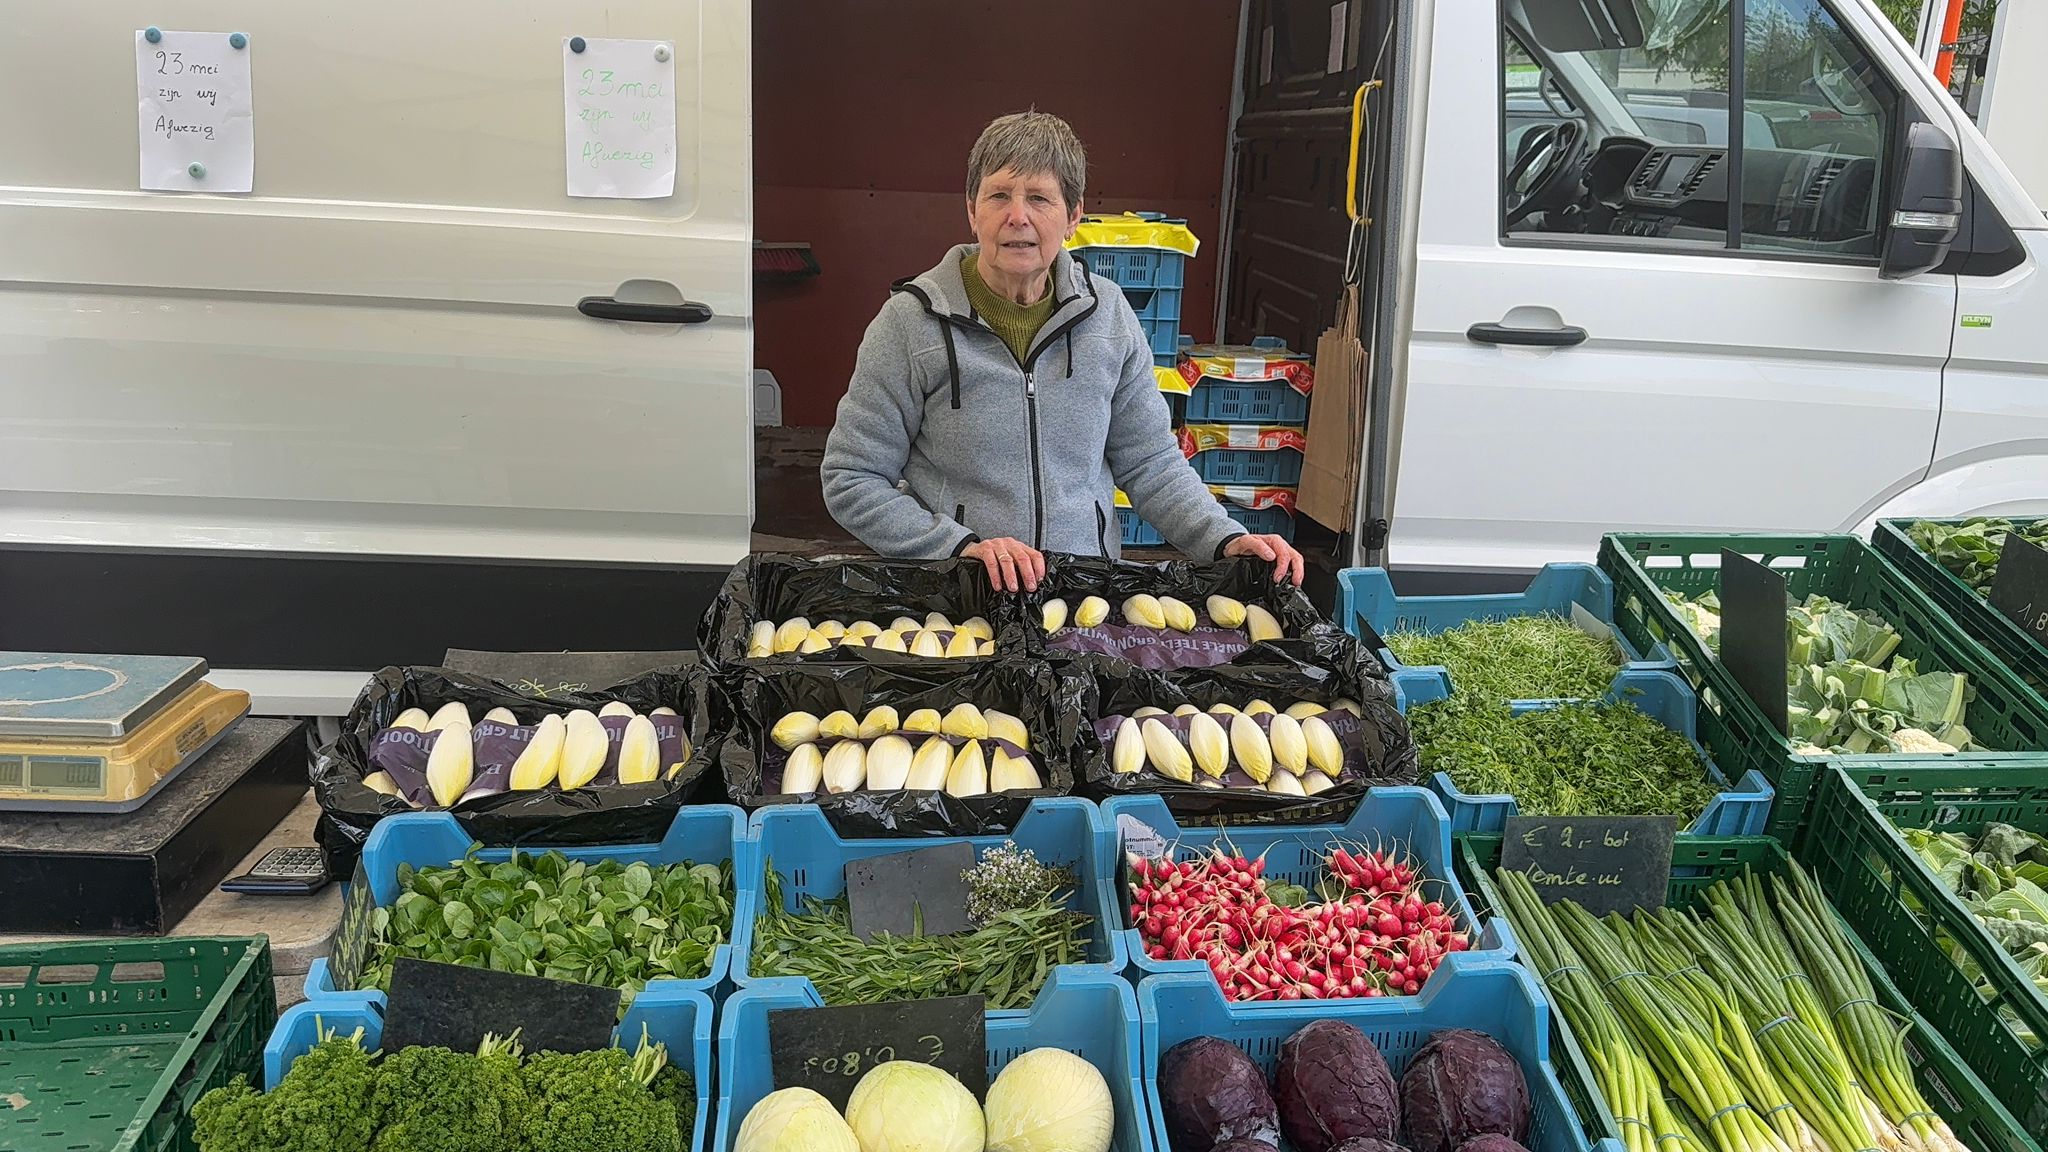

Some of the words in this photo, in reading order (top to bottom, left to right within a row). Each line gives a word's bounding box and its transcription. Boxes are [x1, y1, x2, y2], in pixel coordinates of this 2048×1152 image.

[155, 50, 184, 75] 23
[189, 63, 219, 75] mei
[578, 68, 614, 96] 23
[617, 82, 664, 99] mei
[154, 114, 216, 141] Afwezig
